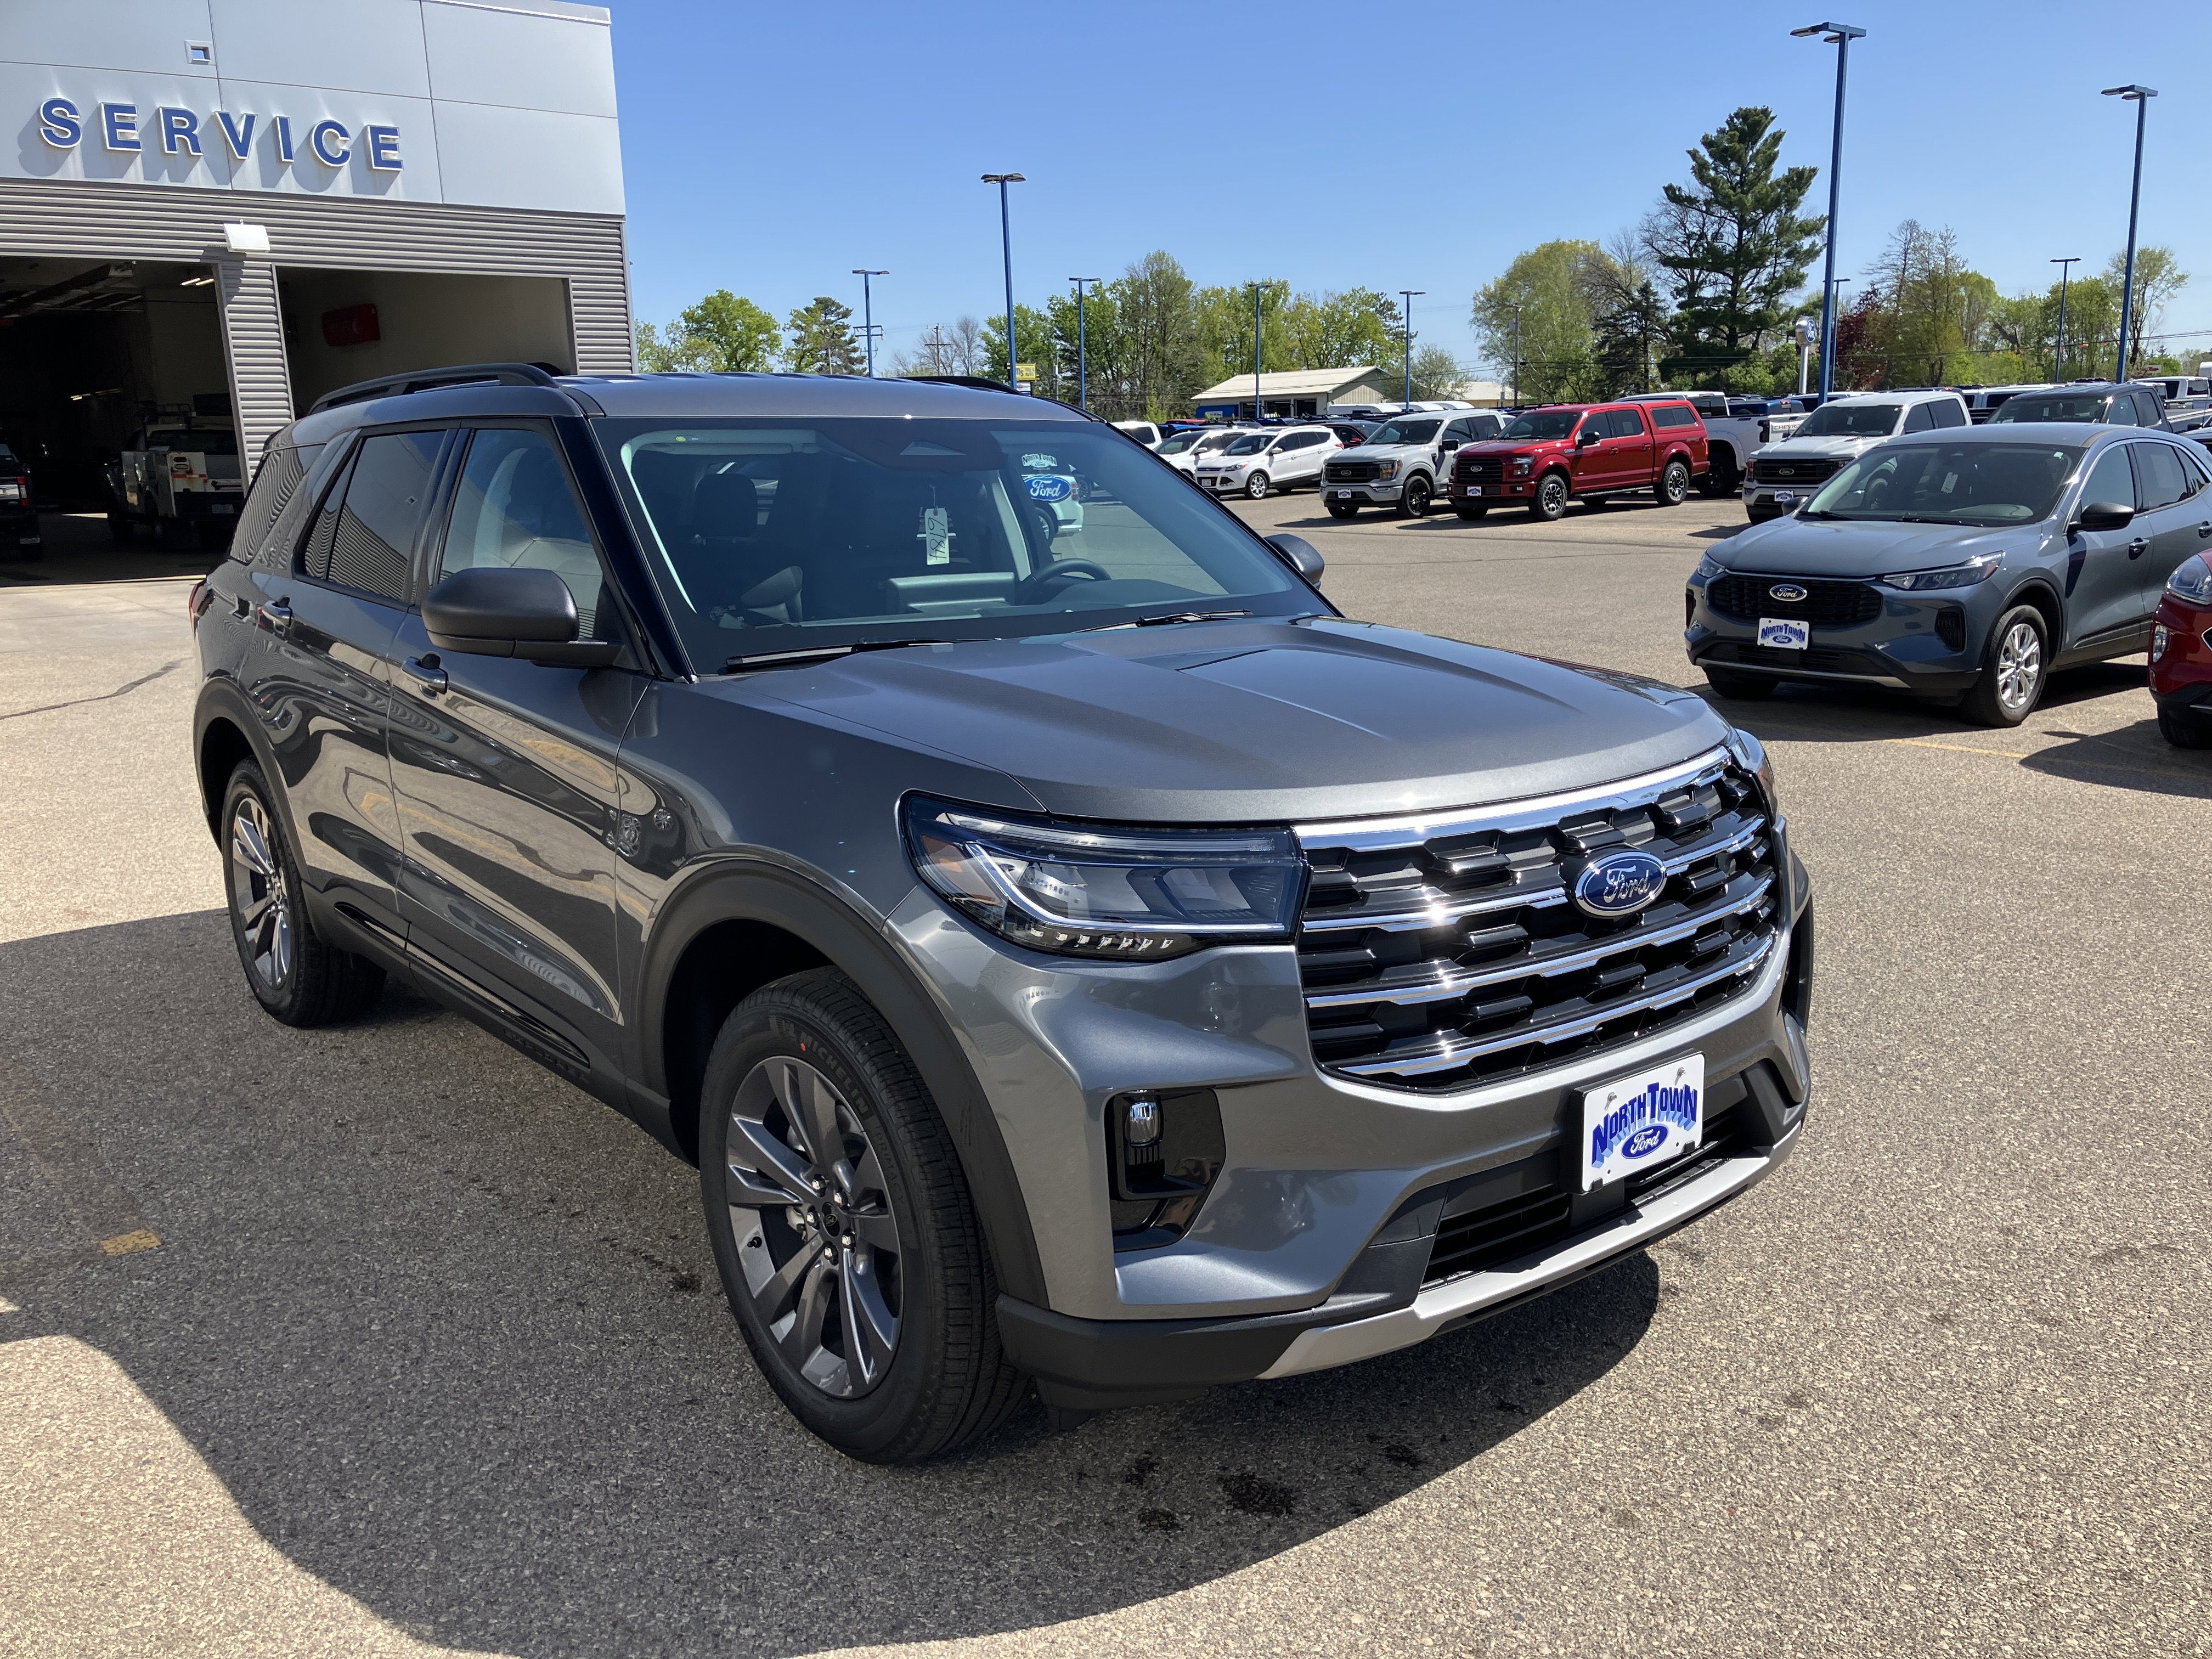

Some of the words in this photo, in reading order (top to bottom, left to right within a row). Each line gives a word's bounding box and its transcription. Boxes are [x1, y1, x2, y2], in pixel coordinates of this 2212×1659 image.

[40, 98, 404, 171] SERVICE
[1030, 479, 1062, 496] Ford
[928, 517, 947, 560] 6784
[1777, 587, 1798, 597] Ford
[1604, 865, 1651, 903] Ford
[799, 1031, 870, 1114] MICHELIN
[1630, 1128, 1661, 1155] Ford
